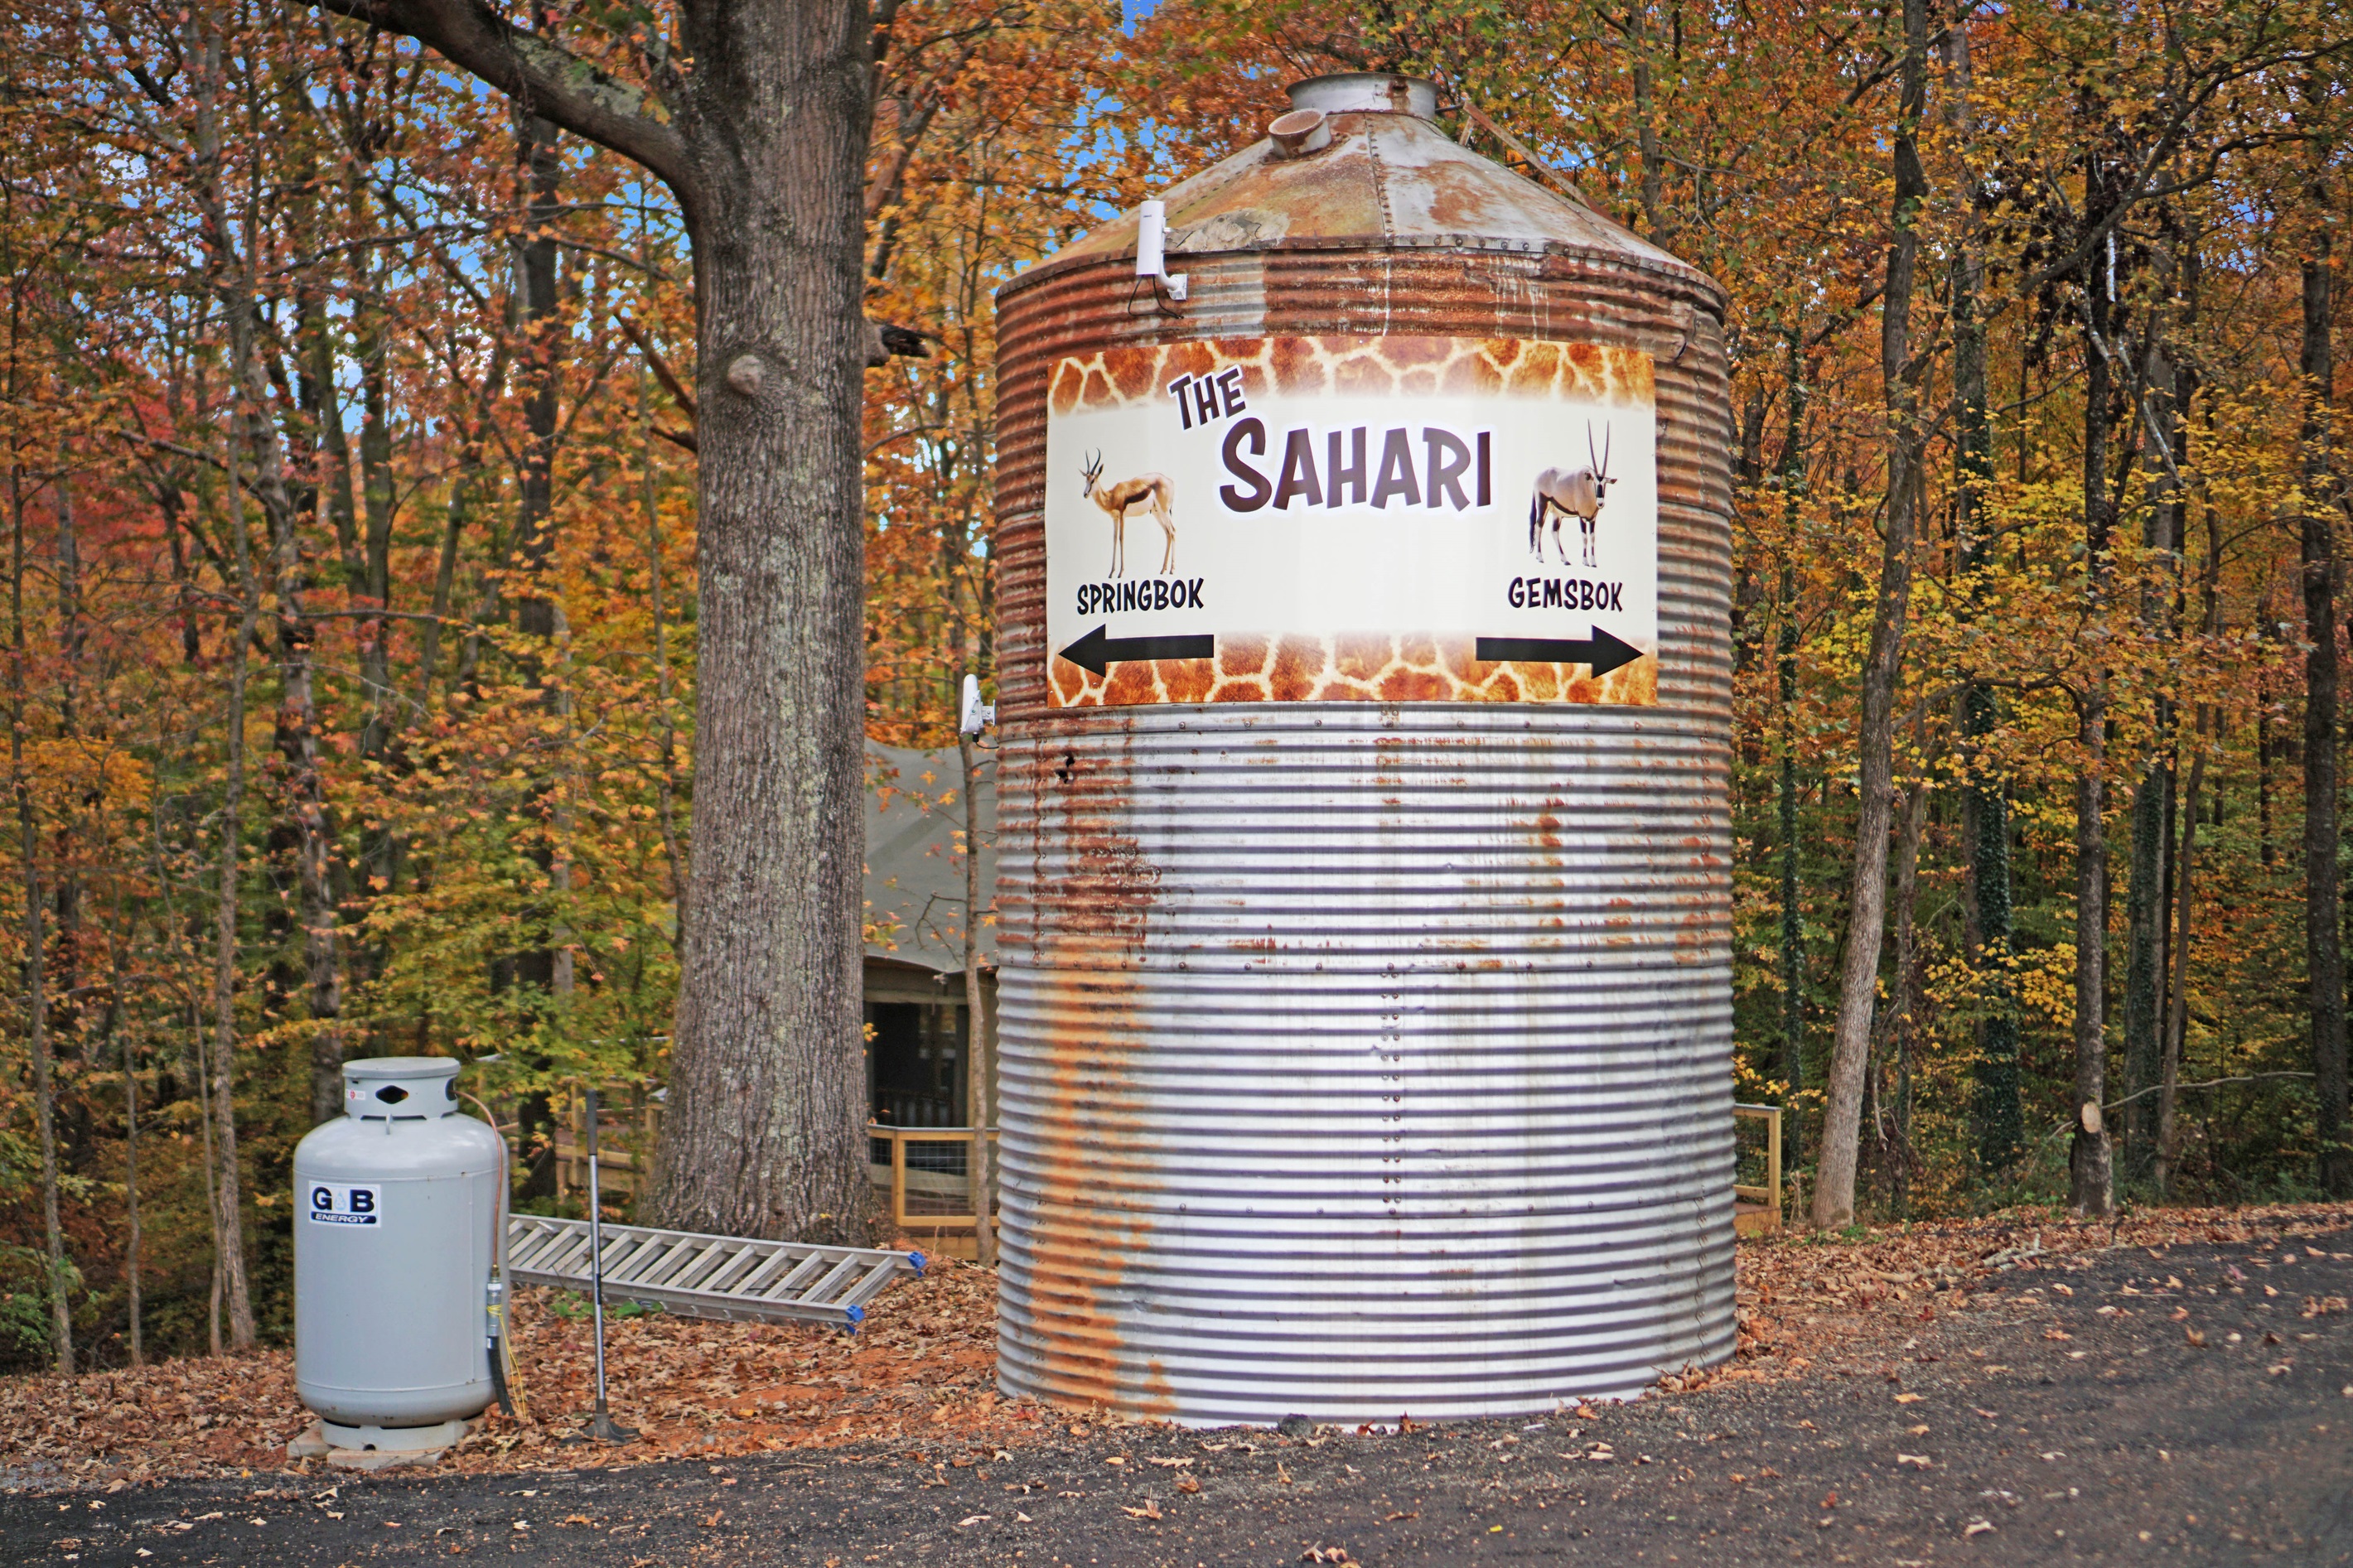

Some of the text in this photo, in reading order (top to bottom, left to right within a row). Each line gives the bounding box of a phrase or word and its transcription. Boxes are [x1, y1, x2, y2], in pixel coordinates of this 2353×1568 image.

[1170, 368, 1246, 429] THE
[1219, 417, 1491, 513] SAHARI
[1077, 577, 1205, 615] SPRINGBOK
[1508, 577, 1623, 612] GEMSBOK
[315, 1213, 368, 1223] ENERGY
